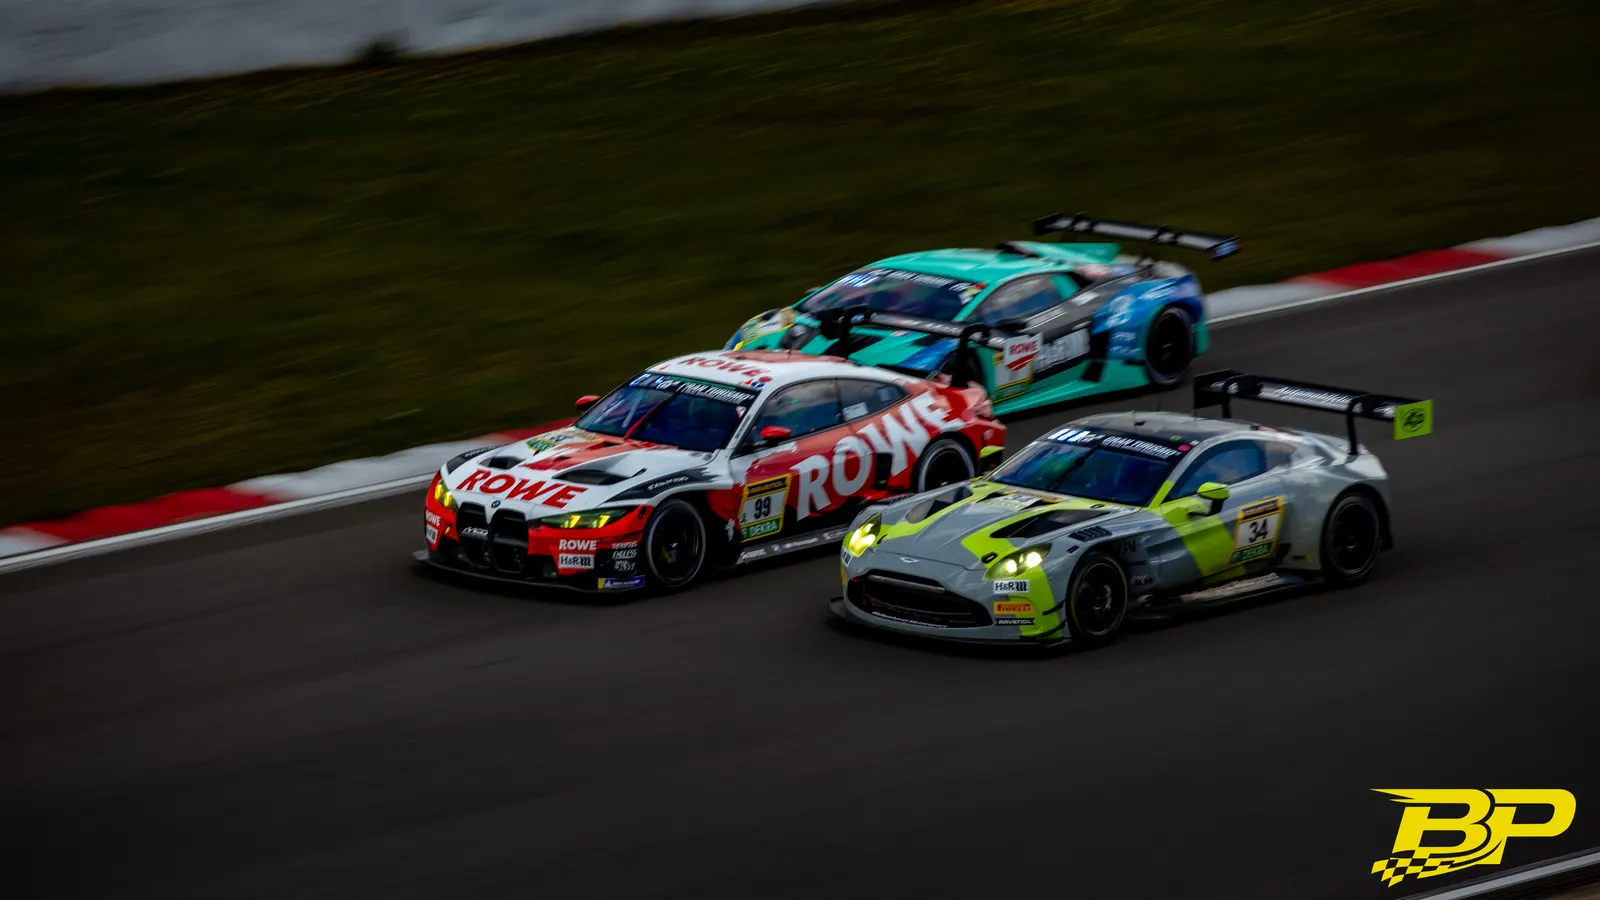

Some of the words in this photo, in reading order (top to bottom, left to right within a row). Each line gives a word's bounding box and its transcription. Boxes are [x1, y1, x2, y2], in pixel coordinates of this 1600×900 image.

[679, 356, 770, 377] ROWE
[788, 390, 967, 522] ROWE
[455, 468, 589, 509] ROWE
[754, 496, 772, 519] 99
[1248, 518, 1268, 543] 34
[558, 539, 598, 551] ROWE
